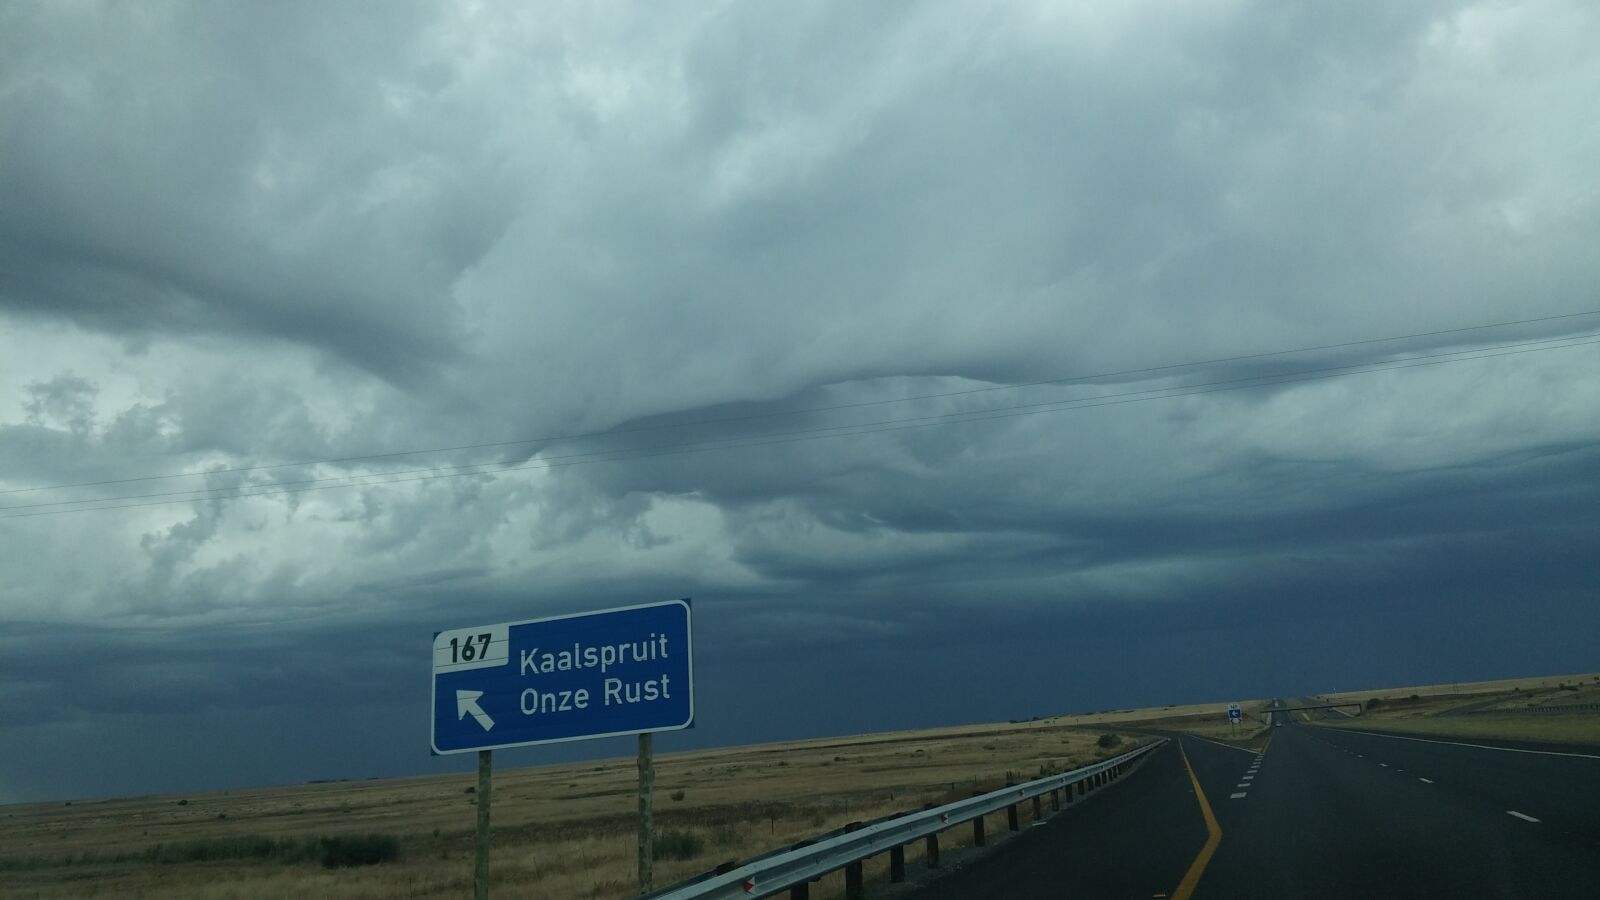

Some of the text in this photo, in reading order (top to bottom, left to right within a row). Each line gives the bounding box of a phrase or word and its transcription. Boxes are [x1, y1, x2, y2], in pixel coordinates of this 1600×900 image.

[450, 633, 492, 663] 167
[520, 633, 669, 676] Kaalspruit
[520, 674, 670, 715] Onze Rust
